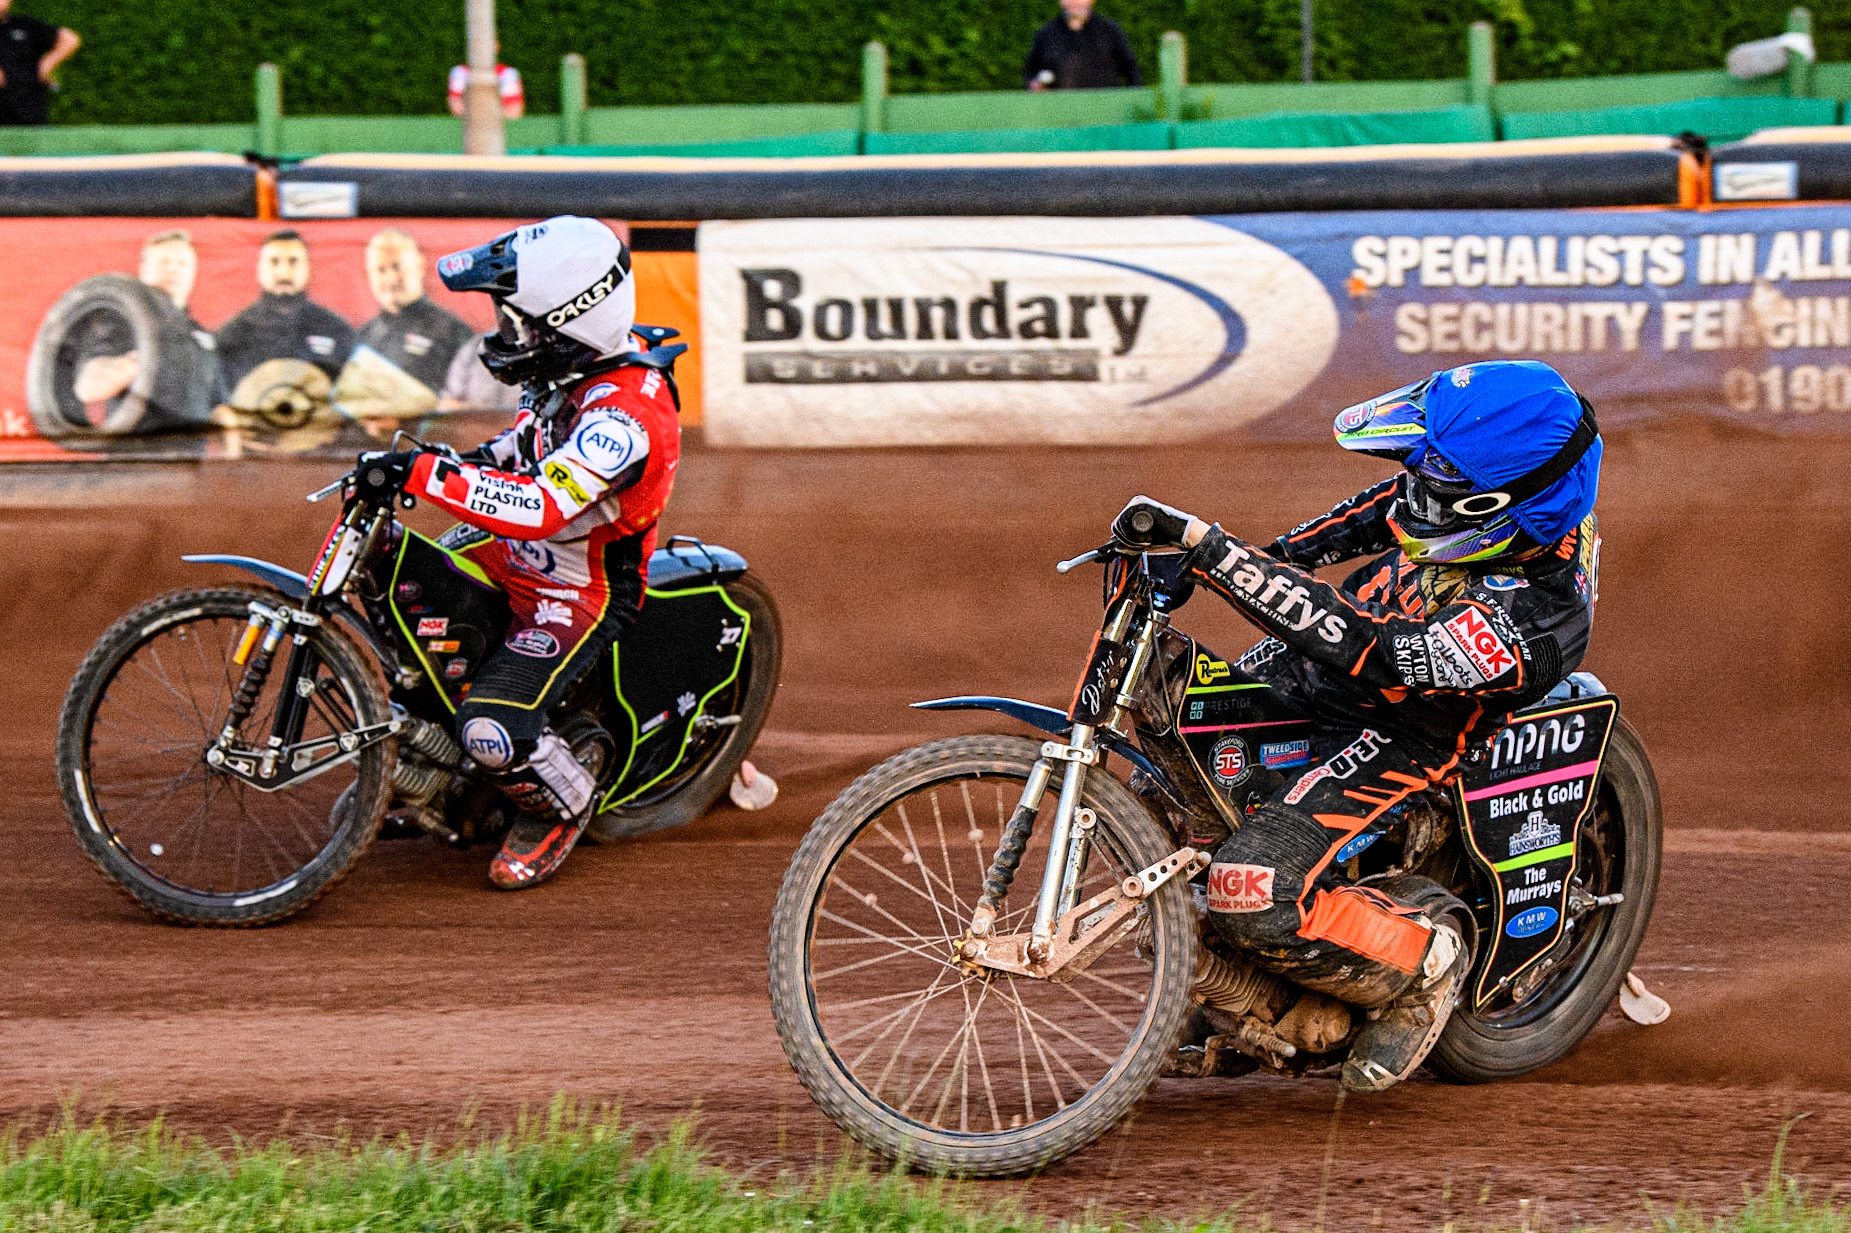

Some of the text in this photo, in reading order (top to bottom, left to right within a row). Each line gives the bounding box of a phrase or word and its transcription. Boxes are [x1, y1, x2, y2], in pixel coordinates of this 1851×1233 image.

[1352, 228, 1851, 288] SPECIALISTS IN ALL
[547, 274, 614, 327] OAKLEY
[739, 267, 1150, 355] Boundary
[1395, 301, 1649, 353] SECURITY
[770, 354, 1075, 379] SERVICES
[586, 432, 625, 459] ATPI
[1370, 425, 1416, 435] CIRCUIT
[470, 499, 498, 515] LTD
[474, 485, 541, 510] PLASTICS
[1216, 540, 1348, 643] Taffys
[1447, 623, 1494, 680] SPARK PLUGS
[1455, 609, 1512, 673] NGK
[1394, 636, 1415, 686] SKIPS
[1409, 633, 1430, 683] W'TON
[1429, 631, 1473, 685] talbots
[1204, 698, 1251, 712] PRESTIGE
[470, 737, 503, 755] ATPI
[1216, 753, 1242, 770] STS
[1263, 739, 1310, 755] TWEEDSIDE
[1287, 767, 1331, 802] Campers
[1490, 779, 1584, 819] Black & Gold
[1208, 867, 1268, 898] NGK
[1506, 879, 1562, 906] Murrays
[1524, 867, 1547, 886] The
